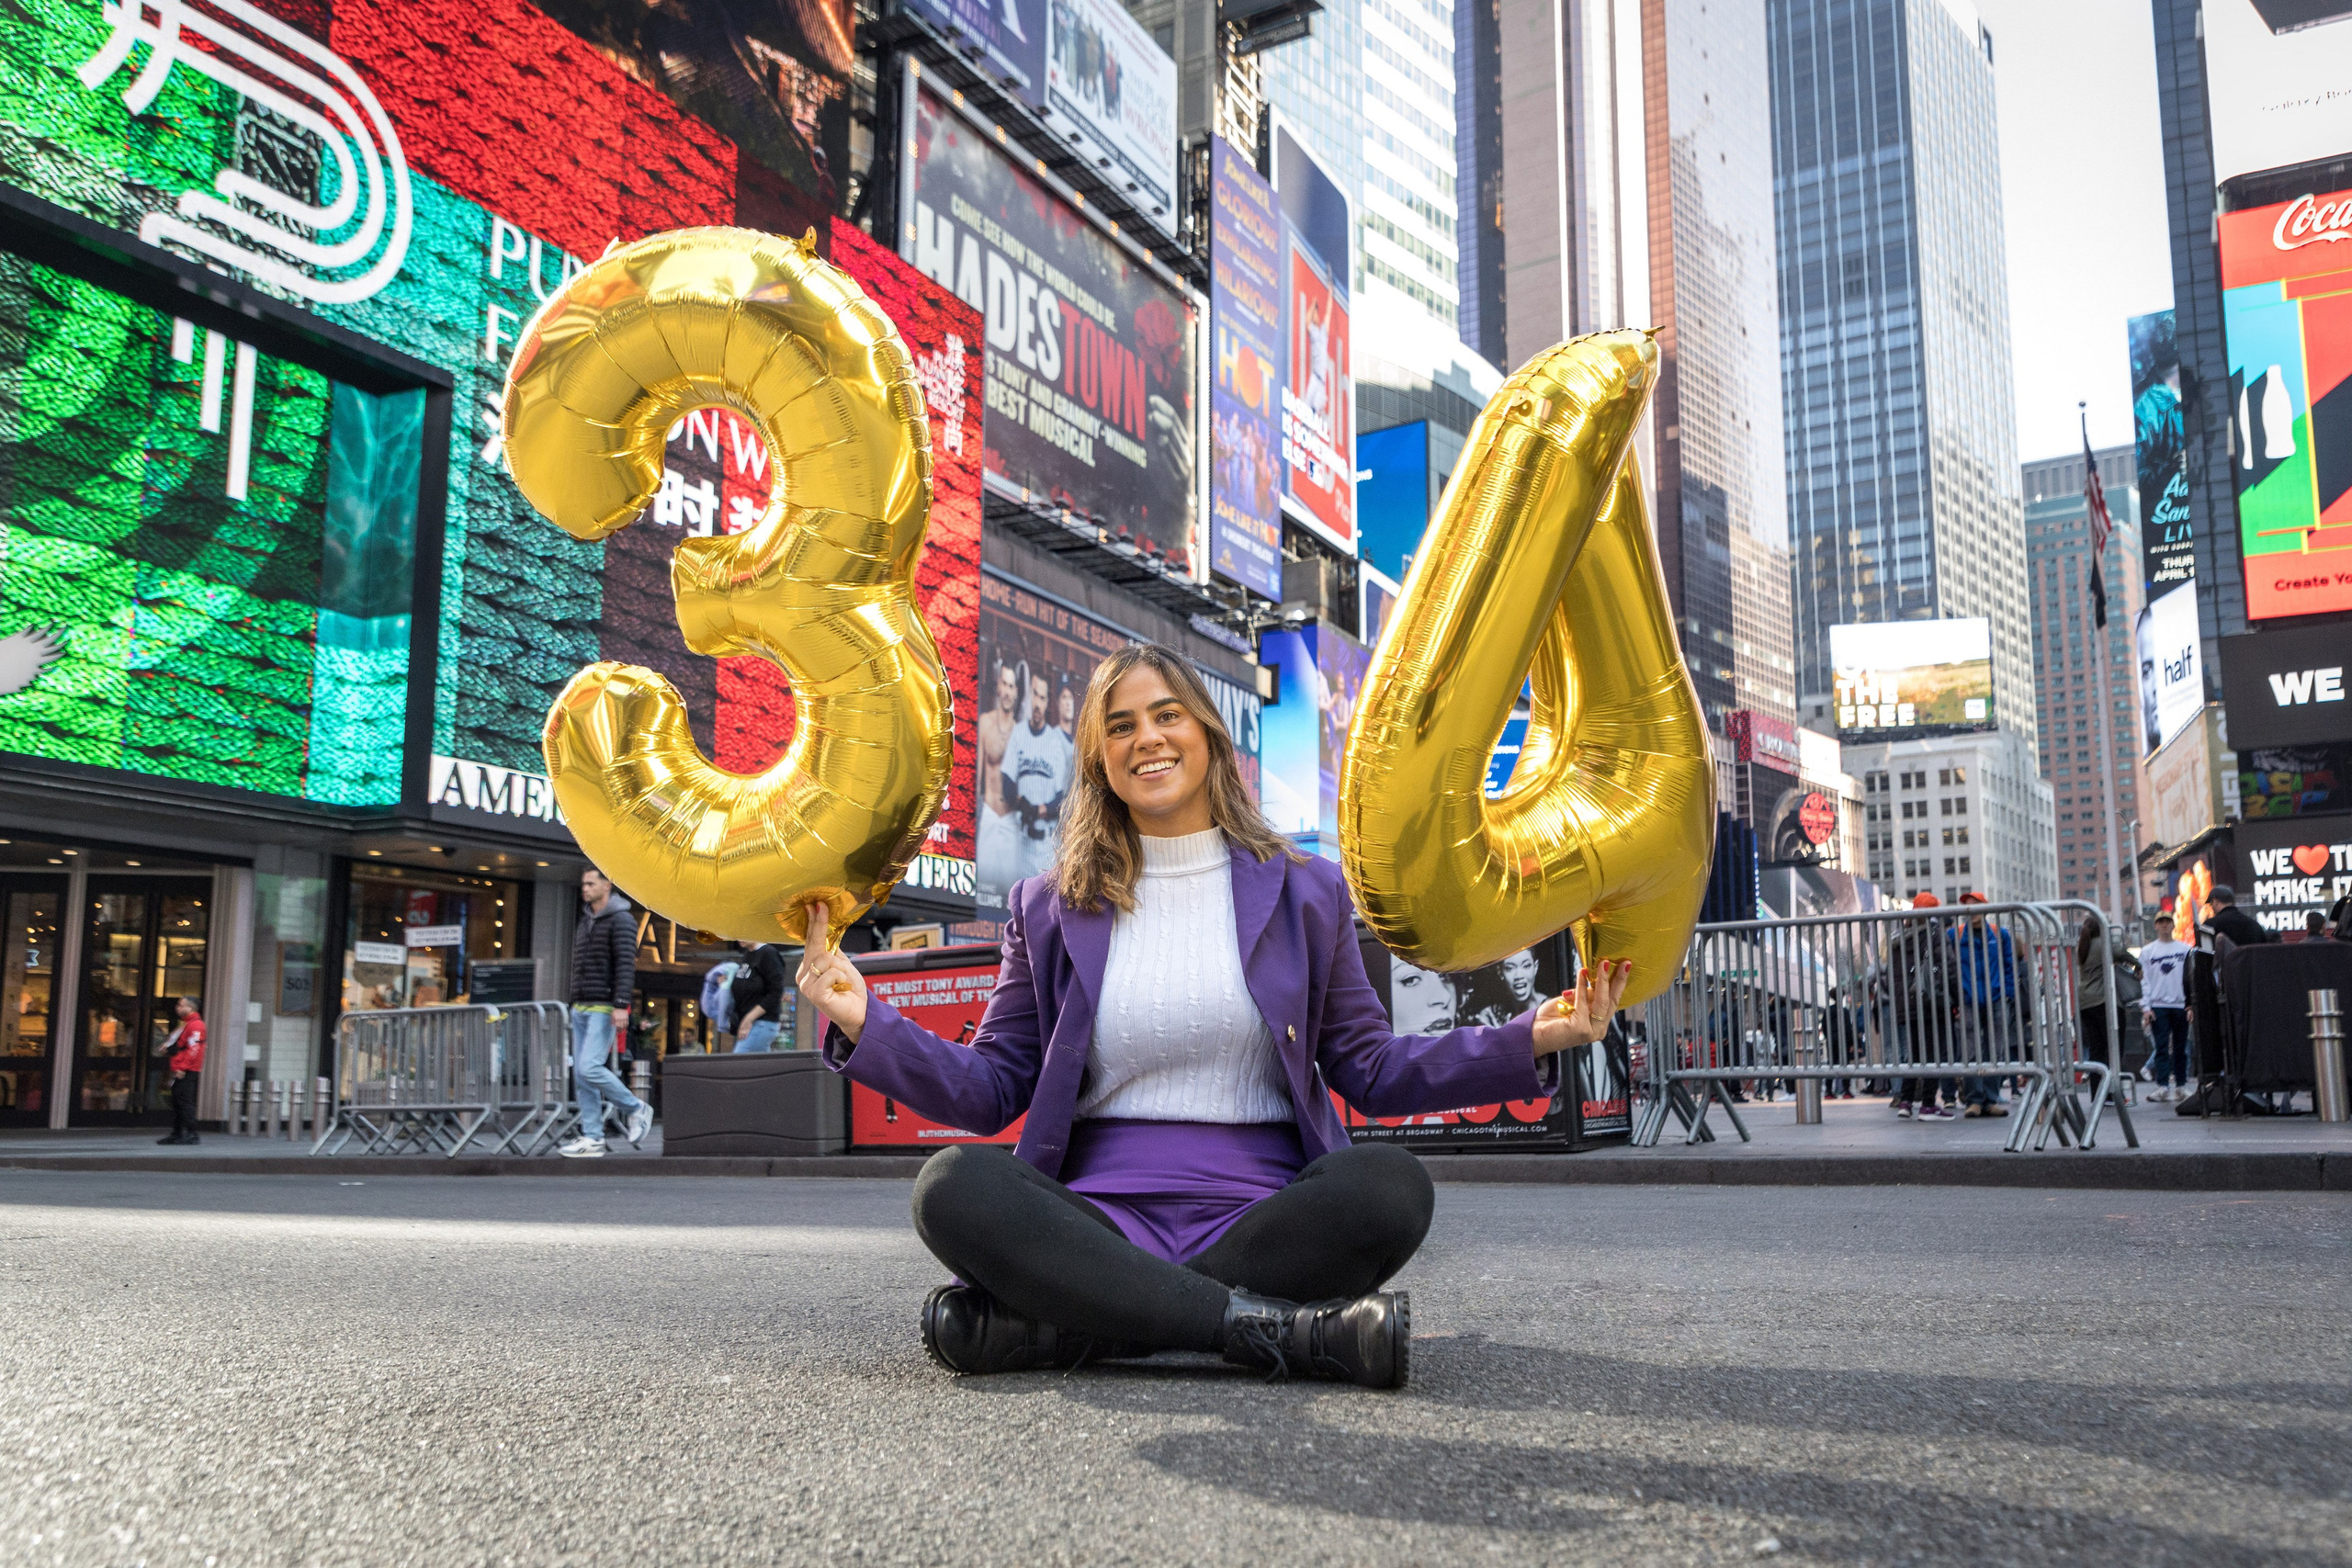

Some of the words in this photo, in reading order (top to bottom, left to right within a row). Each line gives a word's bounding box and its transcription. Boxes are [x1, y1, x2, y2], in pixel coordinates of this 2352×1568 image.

[951, 192, 983, 235] COME
[983, 216, 1002, 246] SEE
[1003, 230, 1025, 265] HOW
[1026, 246, 1045, 280] THE
[1218, 326, 1275, 419] HOT
[1029, 378, 1054, 411] AND
[987, 376, 1028, 425] BEST
[1029, 400, 1096, 468] MUSICAL
[2154, 568, 2188, 583] APRIL
[2274, 574, 2330, 592] Create
[2164, 645, 2194, 687] half
[1836, 675, 1899, 706] THE
[2267, 666, 2346, 707] WE
[1839, 703, 1916, 728] FREE
[2250, 847, 2295, 876] WE
[2253, 876, 2325, 906] MAKE
[873, 982, 893, 996] THE
[895, 979, 923, 995] MOST
[925, 977, 954, 992] TONY
[886, 994, 911, 1010] NEW
[912, 991, 959, 1008] MUSICAL
[961, 989, 975, 1004] OF
[976, 988, 992, 1003] TH
[1582, 1098, 1627, 1119] CHICAGO
[1371, 1129, 1394, 1138] STREET
[1396, 1129, 1405, 1137] AT
[1407, 1128, 1444, 1137] BROADWAY
